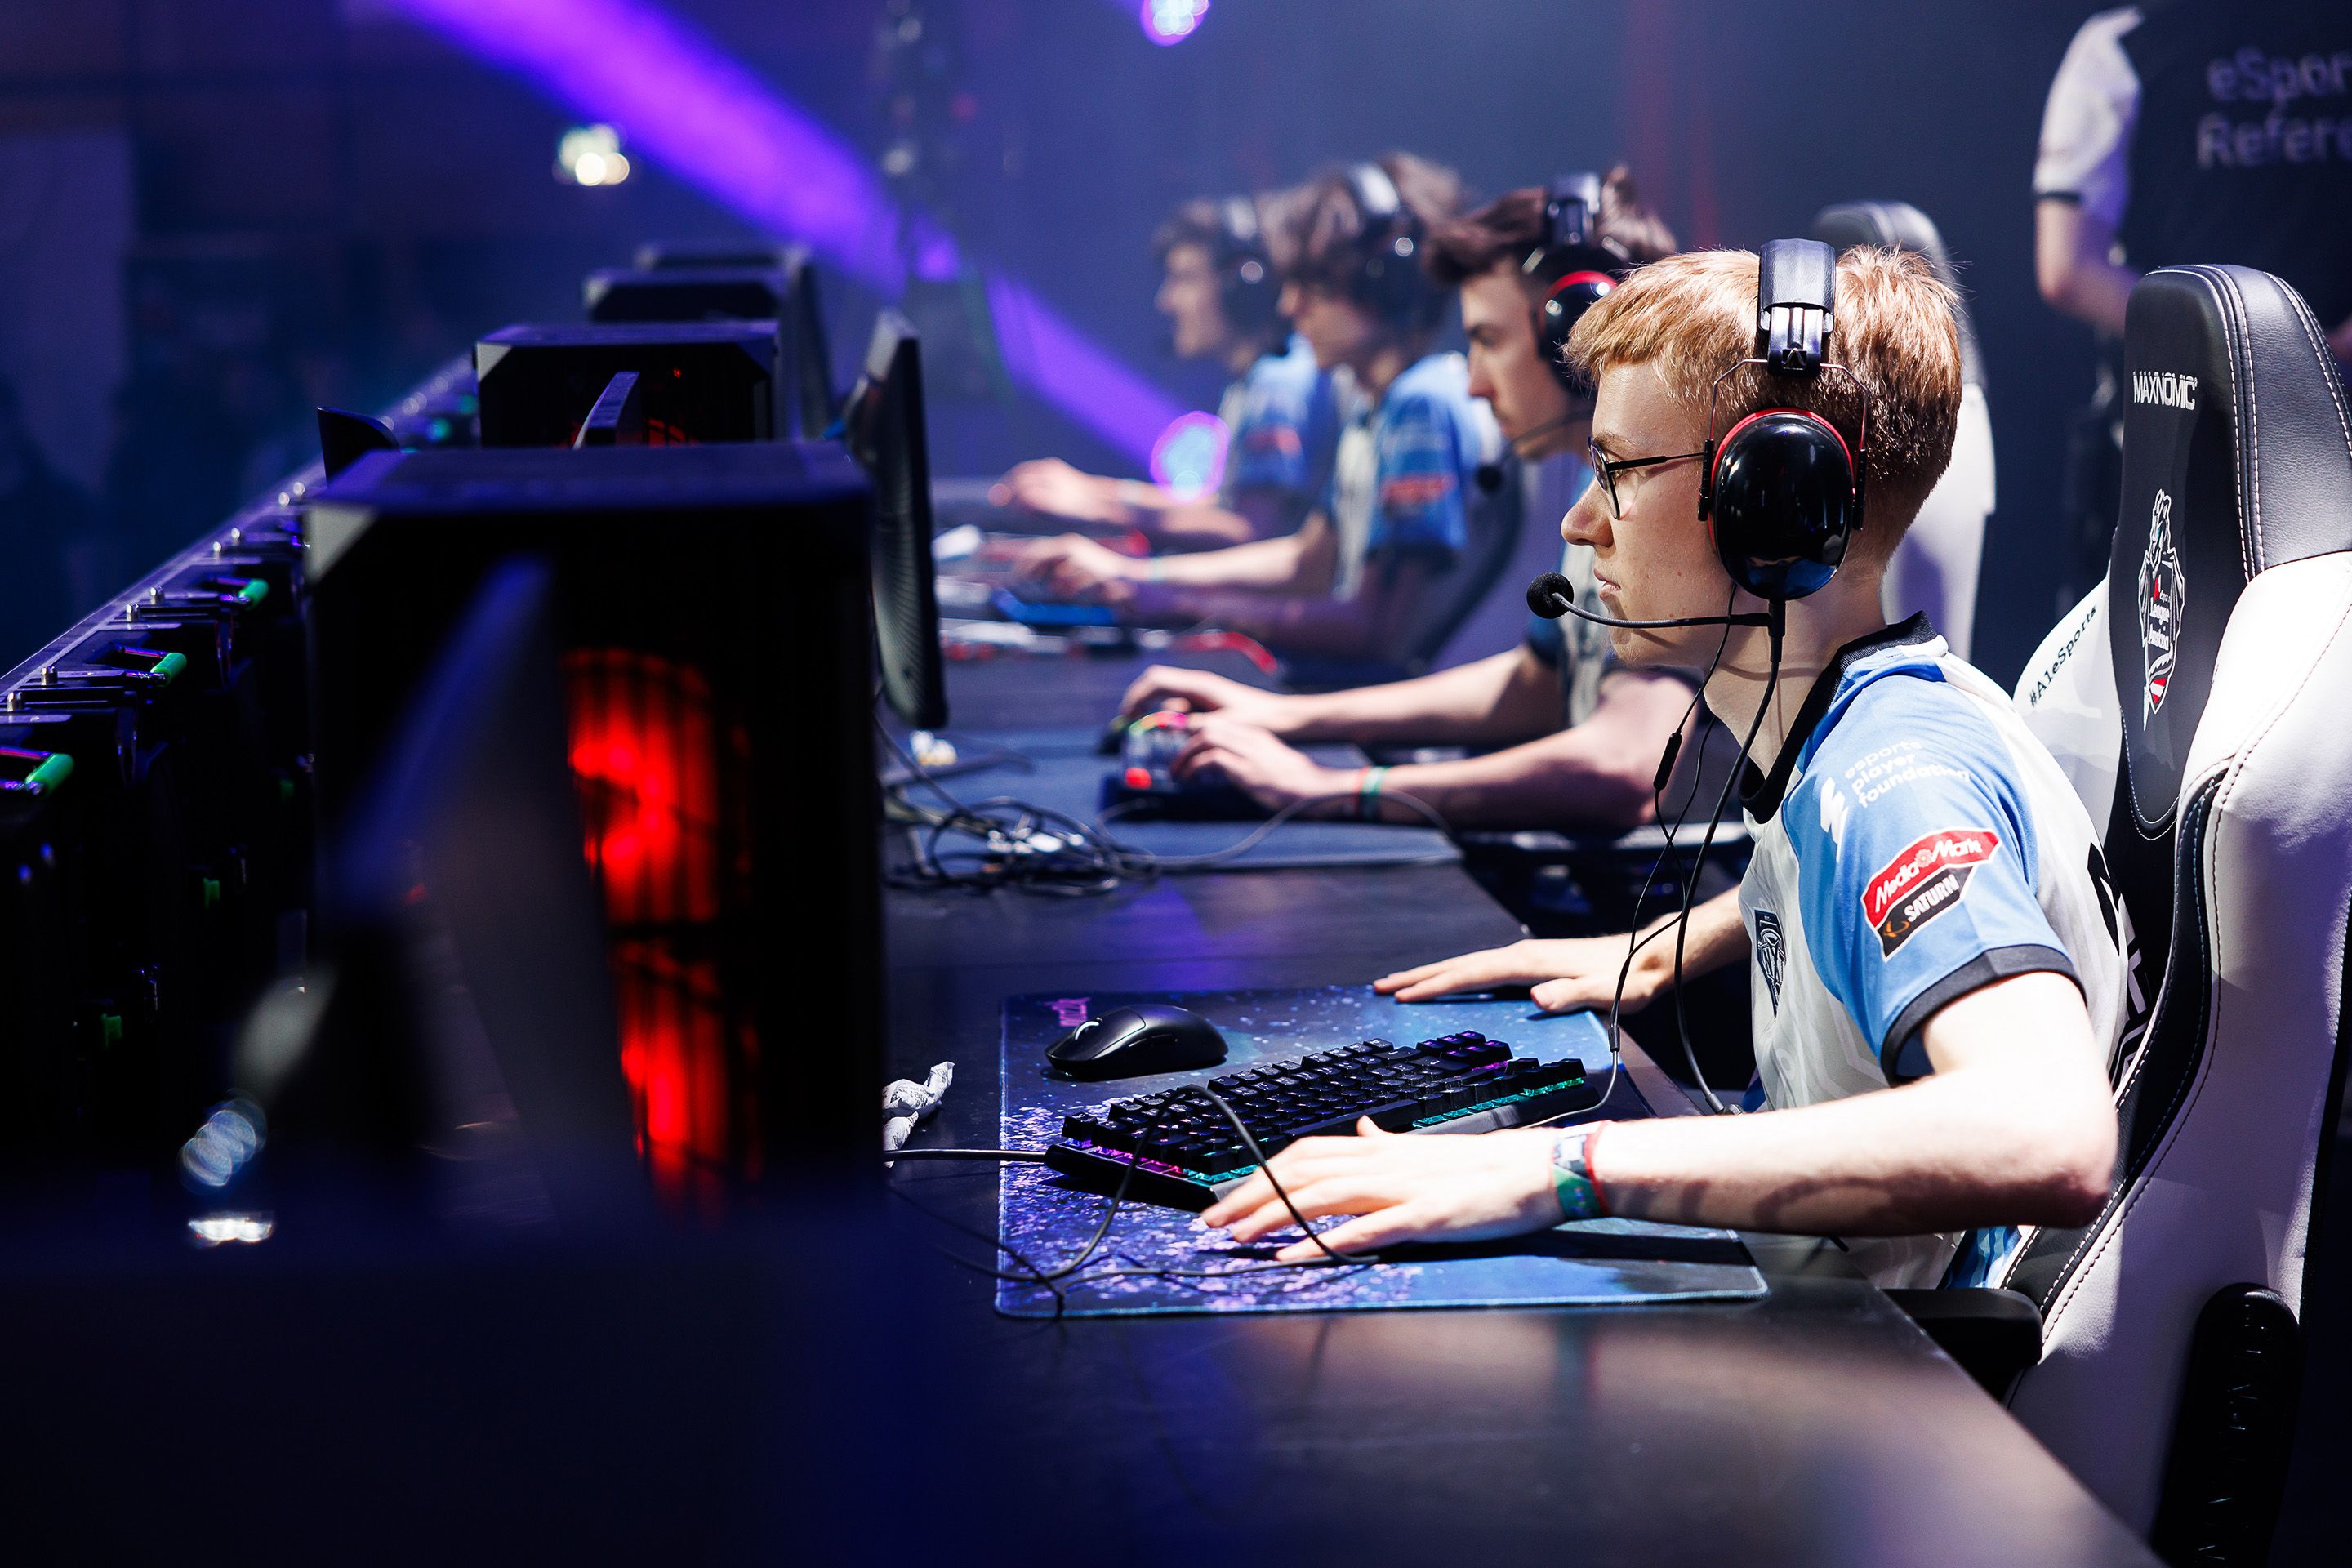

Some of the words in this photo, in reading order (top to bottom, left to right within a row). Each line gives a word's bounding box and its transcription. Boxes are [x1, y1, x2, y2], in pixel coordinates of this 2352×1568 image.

[2133, 371, 2195, 411] MAXNOMIC
[1845, 741, 1922, 779] esports
[1851, 754, 1915, 795] player
[1904, 874, 1960, 923] SATURN
